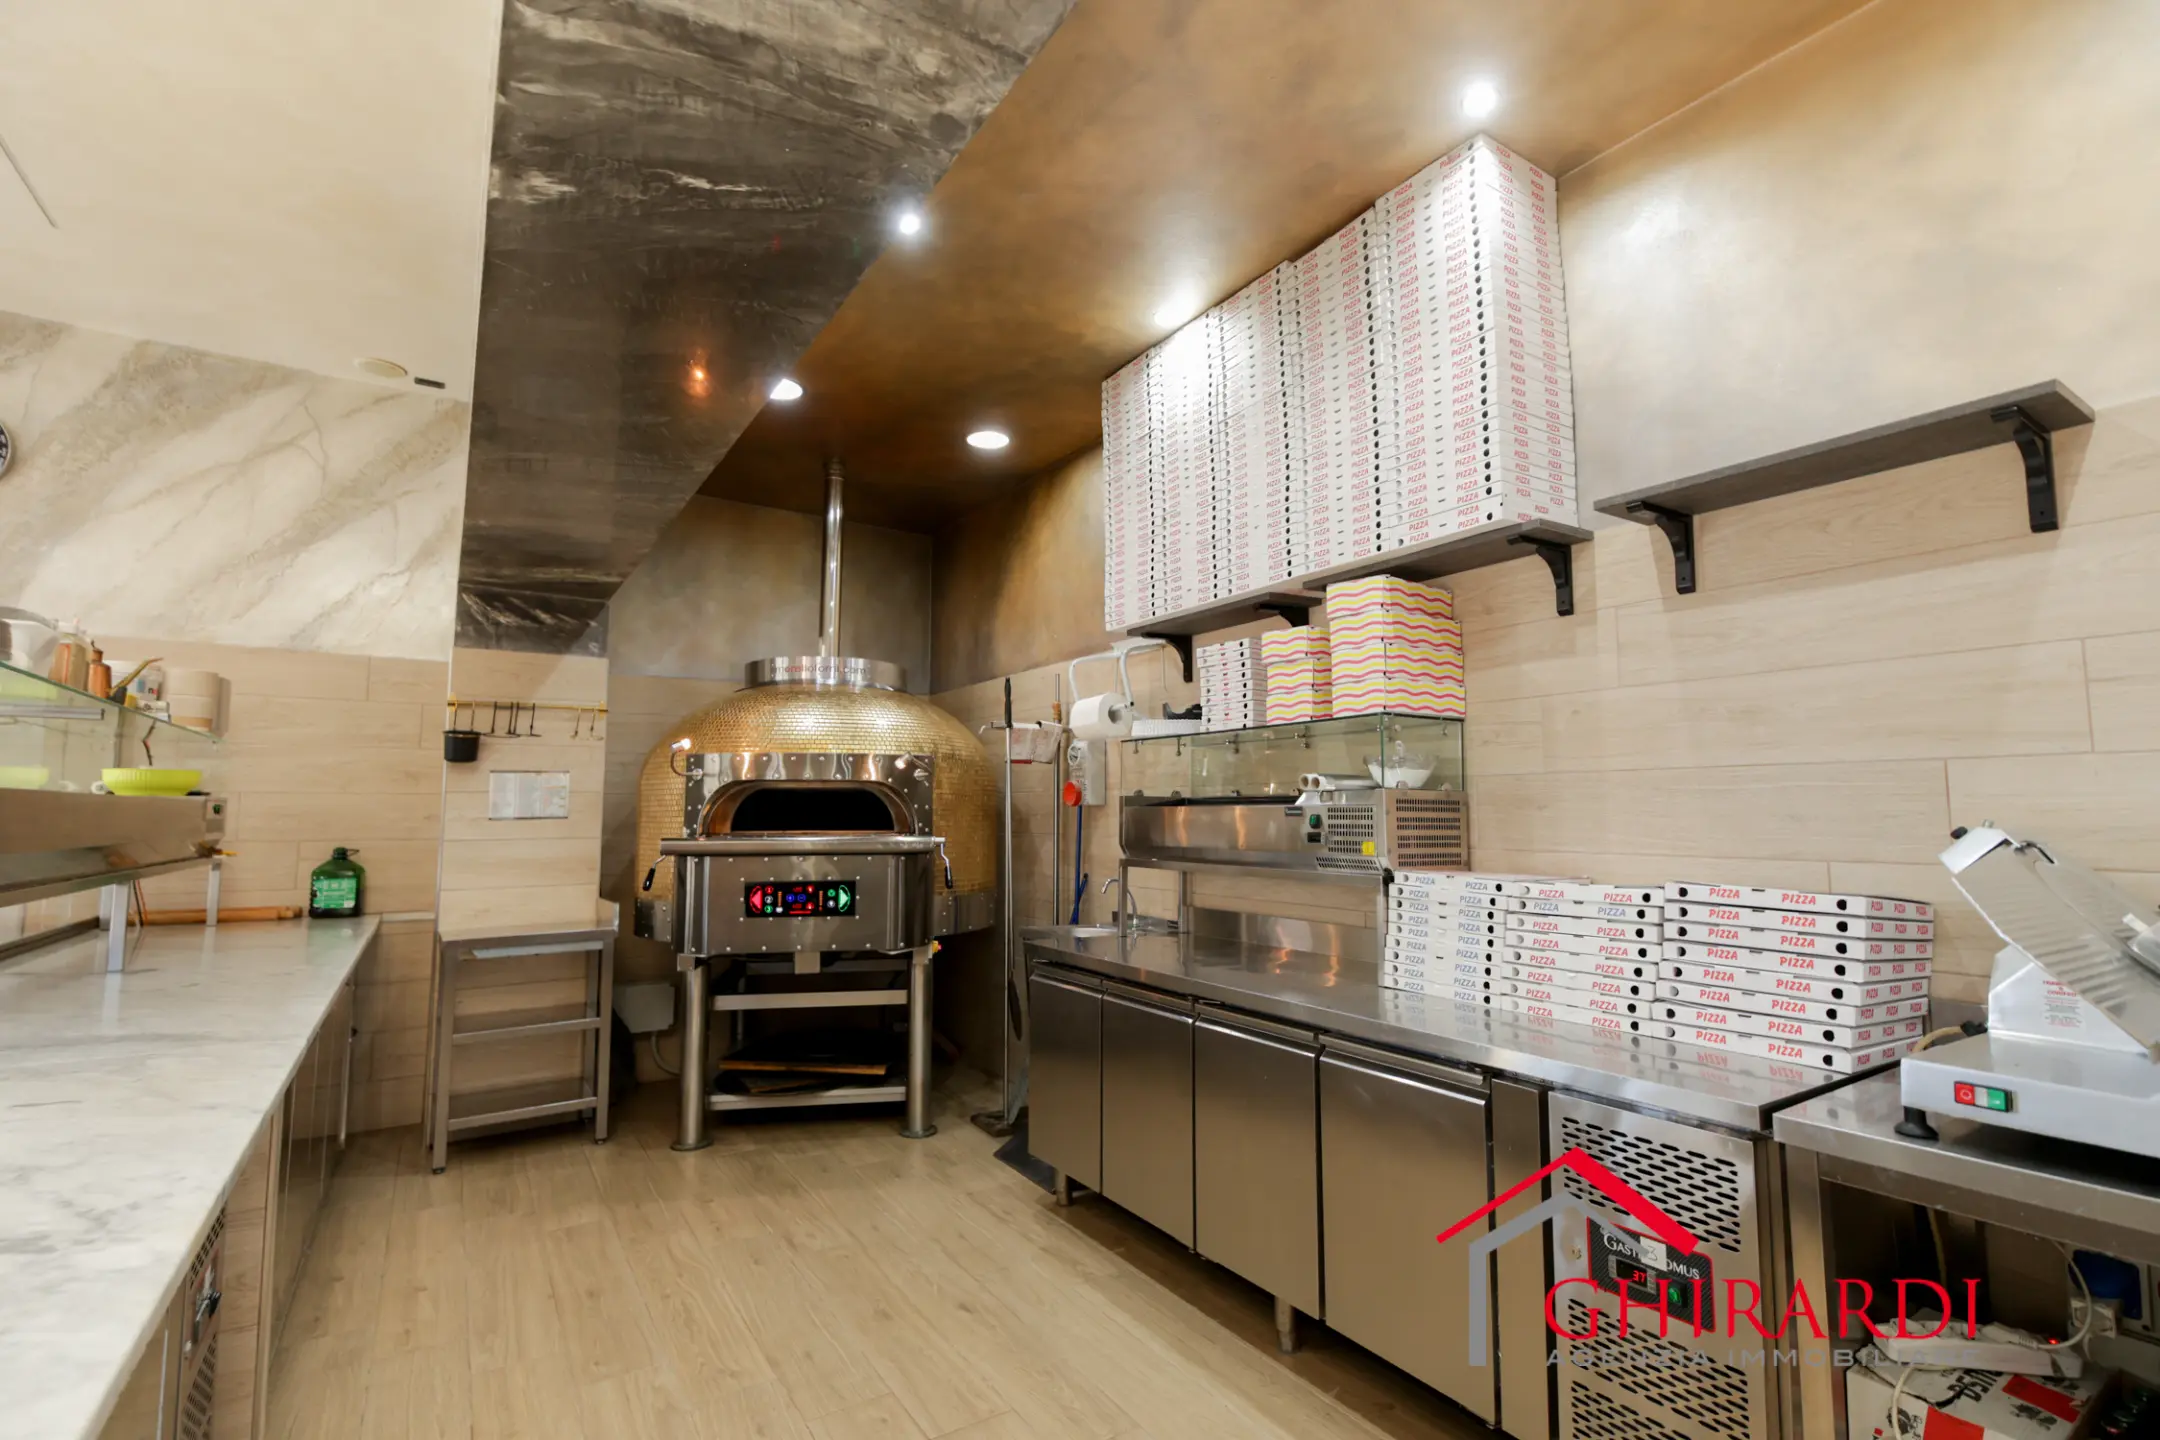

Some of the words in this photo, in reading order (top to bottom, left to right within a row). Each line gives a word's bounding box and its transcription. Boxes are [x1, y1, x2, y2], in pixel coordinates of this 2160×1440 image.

[1449, 308, 1469, 321] PIZZA
[1449, 320, 1470, 334] PIZZA
[1450, 332, 1471, 345] PIZZA
[1450, 344, 1471, 357] PIZZA
[1451, 356, 1472, 369] PIZZA
[1452, 368, 1472, 381] PIZZA
[1452, 380, 1473, 393] PIZZA
[1453, 392, 1474, 405] PIZZA
[1454, 404, 1474, 417] PIZZA
[1454, 417, 1475, 429] PIZZA
[1455, 430, 1476, 442] PIZZA
[1456, 442, 1476, 454] PIZZA
[1456, 455, 1477, 466] PIZZA
[1457, 467, 1478, 479] PIZZA
[1458, 480, 1478, 492] PIZZA
[1458, 493, 1479, 504] PIZZA
[1459, 505, 1480, 516] PIZZA
[1460, 517, 1480, 528] PIZZA
[1416, 877, 1435, 885] PIZZA
[1465, 882, 1487, 890] PIZZA
[1409, 890, 1429, 898] PIZZA
[1460, 896, 1482, 904] PIZZA
[1538, 890, 1565, 898] PIZZA
[1604, 893, 1632, 903] PIZZA
[1710, 888, 1740, 899] PIZZA
[1782, 893, 1816, 905] PIZZA
[1409, 902, 1428, 911] PIZZA
[1459, 909, 1480, 918] PIZZA
[1533, 903, 1558, 912] PIZZA
[1597, 907, 1626, 916] PIZZA
[1871, 901, 1883, 912] PIZZA
[1894, 903, 1905, 914] PIZZA
[1916, 906, 1926, 916] PIZZA
[1408, 916, 1428, 924] PIZZA
[1459, 923, 1480, 931] PIZZA
[1709, 908, 1740, 920] PIZZA
[1781, 915, 1816, 927] PIZZA
[1534, 920, 1559, 931] PIZZA
[1597, 927, 1626, 937] PIZZA
[1871, 922, 1883, 932] PIZZA
[1895, 924, 1907, 933] PIZZA
[1917, 925, 1928, 934] PIZZA
[1408, 929, 1428, 937] PIZZA
[1458, 936, 1480, 945] PIZZA
[1708, 927, 1739, 940] PIZZA
[1780, 935, 1815, 948] PIZZA
[1407, 941, 1426, 951] PIZZA
[1456, 949, 1478, 960] PIZZA
[1532, 939, 1559, 949] PIZZA
[1600, 945, 1629, 956] PIZZA
[1870, 944, 1882, 954] PIZZA
[1894, 944, 1905, 954] PIZZA
[1916, 944, 1927, 954] PIZZA
[1405, 955, 1425, 964] PIZZA
[1455, 964, 1477, 974] PIZZA
[1530, 954, 1556, 966] PIZZA
[1595, 964, 1624, 975] PIZZA
[1707, 947, 1738, 960] PIZZA
[1779, 956, 1815, 969] PIZZA
[1869, 966, 1880, 976] PIZZA
[1893, 964, 1904, 974] PIZZA
[1915, 963, 1926, 973] PIZZA
[1404, 968, 1424, 977] PIZZA
[1454, 978, 1476, 988] PIZZA
[1528, 972, 1553, 982] PIZZA
[1593, 981, 1620, 993] PIZZA
[1704, 969, 1735, 983] PIZZA
[1776, 979, 1811, 994] PIZZA
[1404, 982, 1424, 991] PIZZA
[1454, 992, 1476, 1001] PIZZA
[1866, 988, 1878, 998] PIZZA
[1890, 986, 1901, 996] PIZZA
[1912, 982, 1922, 992] PIZZA
[1528, 988, 1551, 999] PIZZA
[1590, 1000, 1617, 1010] PIZZA
[1699, 989, 1730, 1002] PIZZA
[1772, 1000, 1806, 1014] PIZZA
[1528, 1006, 1552, 1016] PIZZA
[1592, 1016, 1620, 1027] PIZZA
[1861, 1008, 1874, 1019] PIZZA
[1886, 1006, 1898, 1016] PIZZA
[1910, 1003, 1922, 1012] PIZZA
[1696, 1011, 1727, 1024] PIZZA
[1768, 1020, 1803, 1035] PIZZA
[1858, 1030, 1870, 1041] PIZZA
[1883, 1026, 1895, 1037] PIZZA
[1906, 1022, 1917, 1032] PIZZA
[1696, 1030, 1727, 1044] PIZZA
[1768, 1043, 1802, 1057] PIZZA
[1858, 1054, 1870, 1066] PIZZA
[1883, 1048, 1895, 1059] PIZZA
